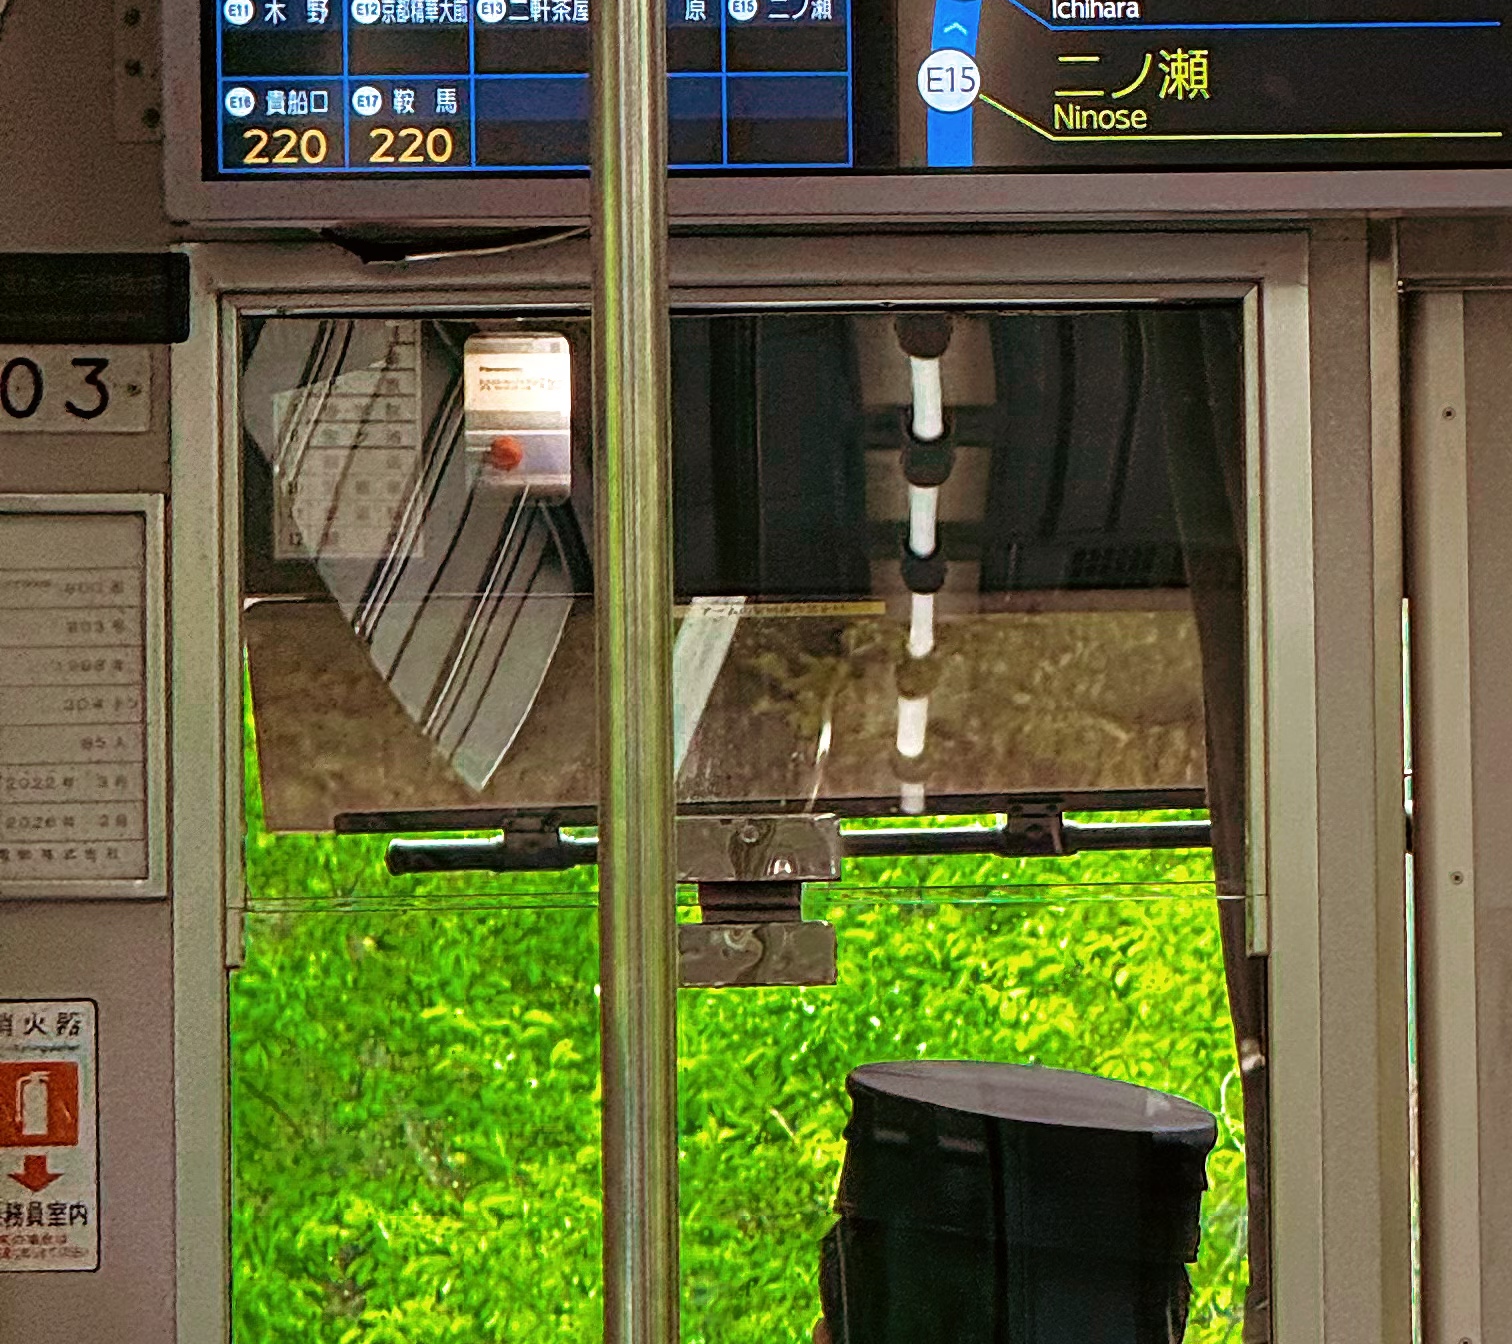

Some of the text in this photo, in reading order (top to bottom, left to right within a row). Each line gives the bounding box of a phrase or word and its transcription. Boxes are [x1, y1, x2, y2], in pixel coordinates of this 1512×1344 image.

[227, 1, 250, 18] E11
[355, 0, 379, 17] E12
[481, 0, 503, 16] E13
[926, 49, 1211, 100] E15 二ノ瀬
[265, 90, 329, 115] 貴船口
[357, 88, 458, 115] E17 鞍馬
[1053, 105, 1148, 131] Ninose
[242, 128, 328, 165] 220
[368, 127, 454, 164] 220
[0, 357, 109, 419] 03
